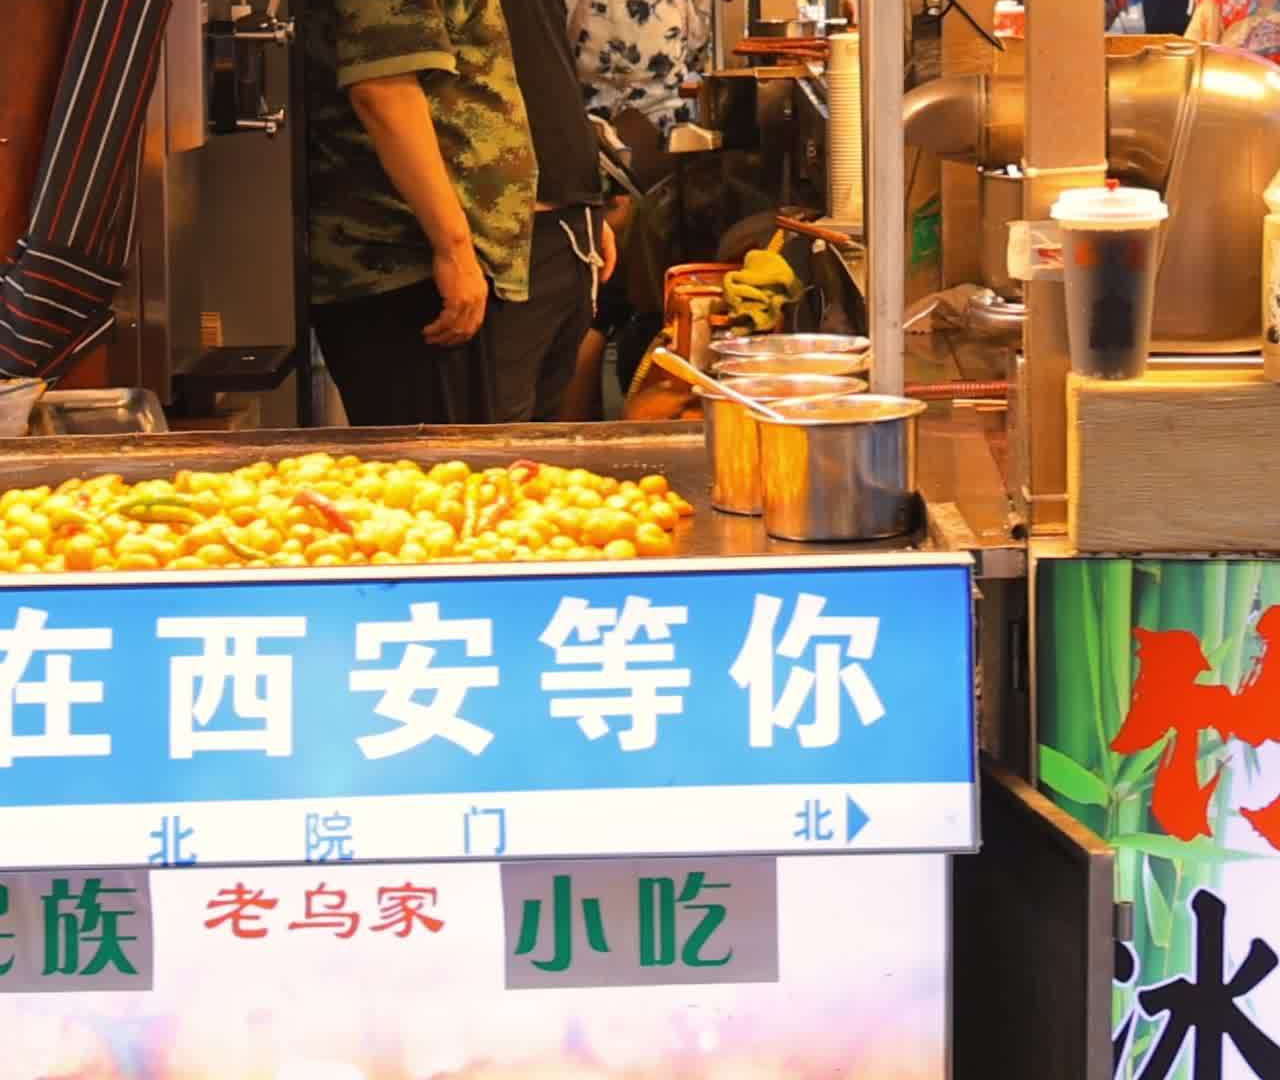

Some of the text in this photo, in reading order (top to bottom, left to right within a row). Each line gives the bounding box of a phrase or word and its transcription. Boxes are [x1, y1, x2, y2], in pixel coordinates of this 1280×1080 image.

[794, 799, 835, 843] 北
[202, 881, 447, 940] 老乌家
[513, 870, 735, 973] 小吃
